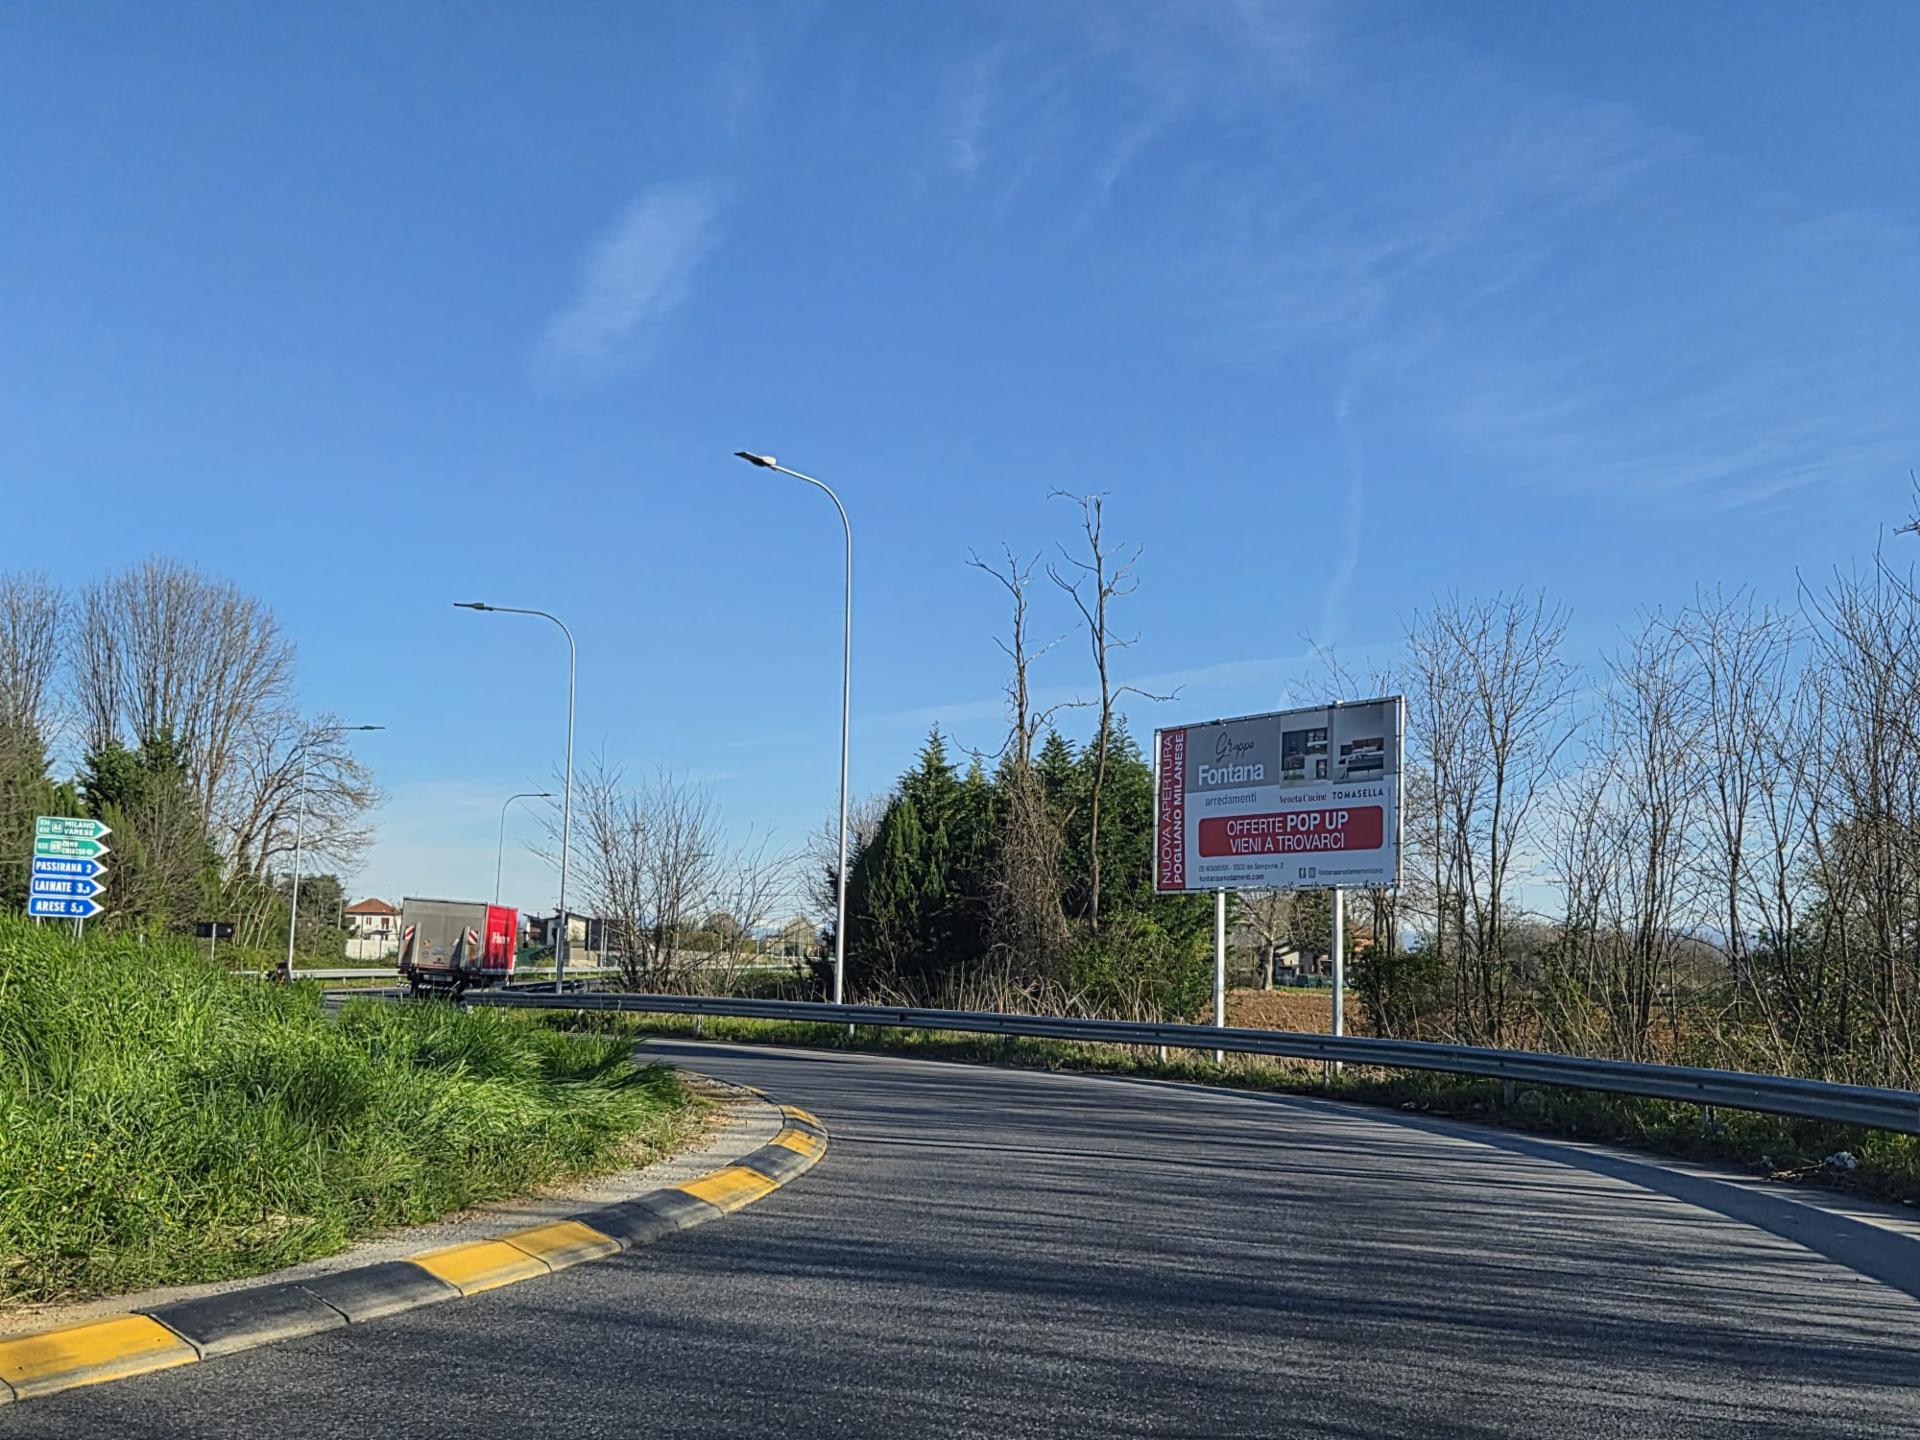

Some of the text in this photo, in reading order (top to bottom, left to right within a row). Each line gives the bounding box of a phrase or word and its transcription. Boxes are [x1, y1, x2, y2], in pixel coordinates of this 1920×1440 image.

[1198, 763, 1264, 786] Fontana
[1205, 793, 1257, 807] arredamenti
[1332, 789, 1383, 800] TOMASELLA
[1162, 735, 1173, 884] NUOVA APERTURA
[1174, 733, 1184, 883] POGLIANO MILANESE
[64, 821, 95, 829] MILANO
[1227, 811, 1349, 836] OFFERTE POP UP
[64, 828, 94, 836] VARESE
[1230, 833, 1344, 853] VIENI A TROVARCI
[36, 861, 92, 873] PASSIRANA 2
[35, 880, 72, 892] LAINATE
[36, 901, 65, 912] ARESE
